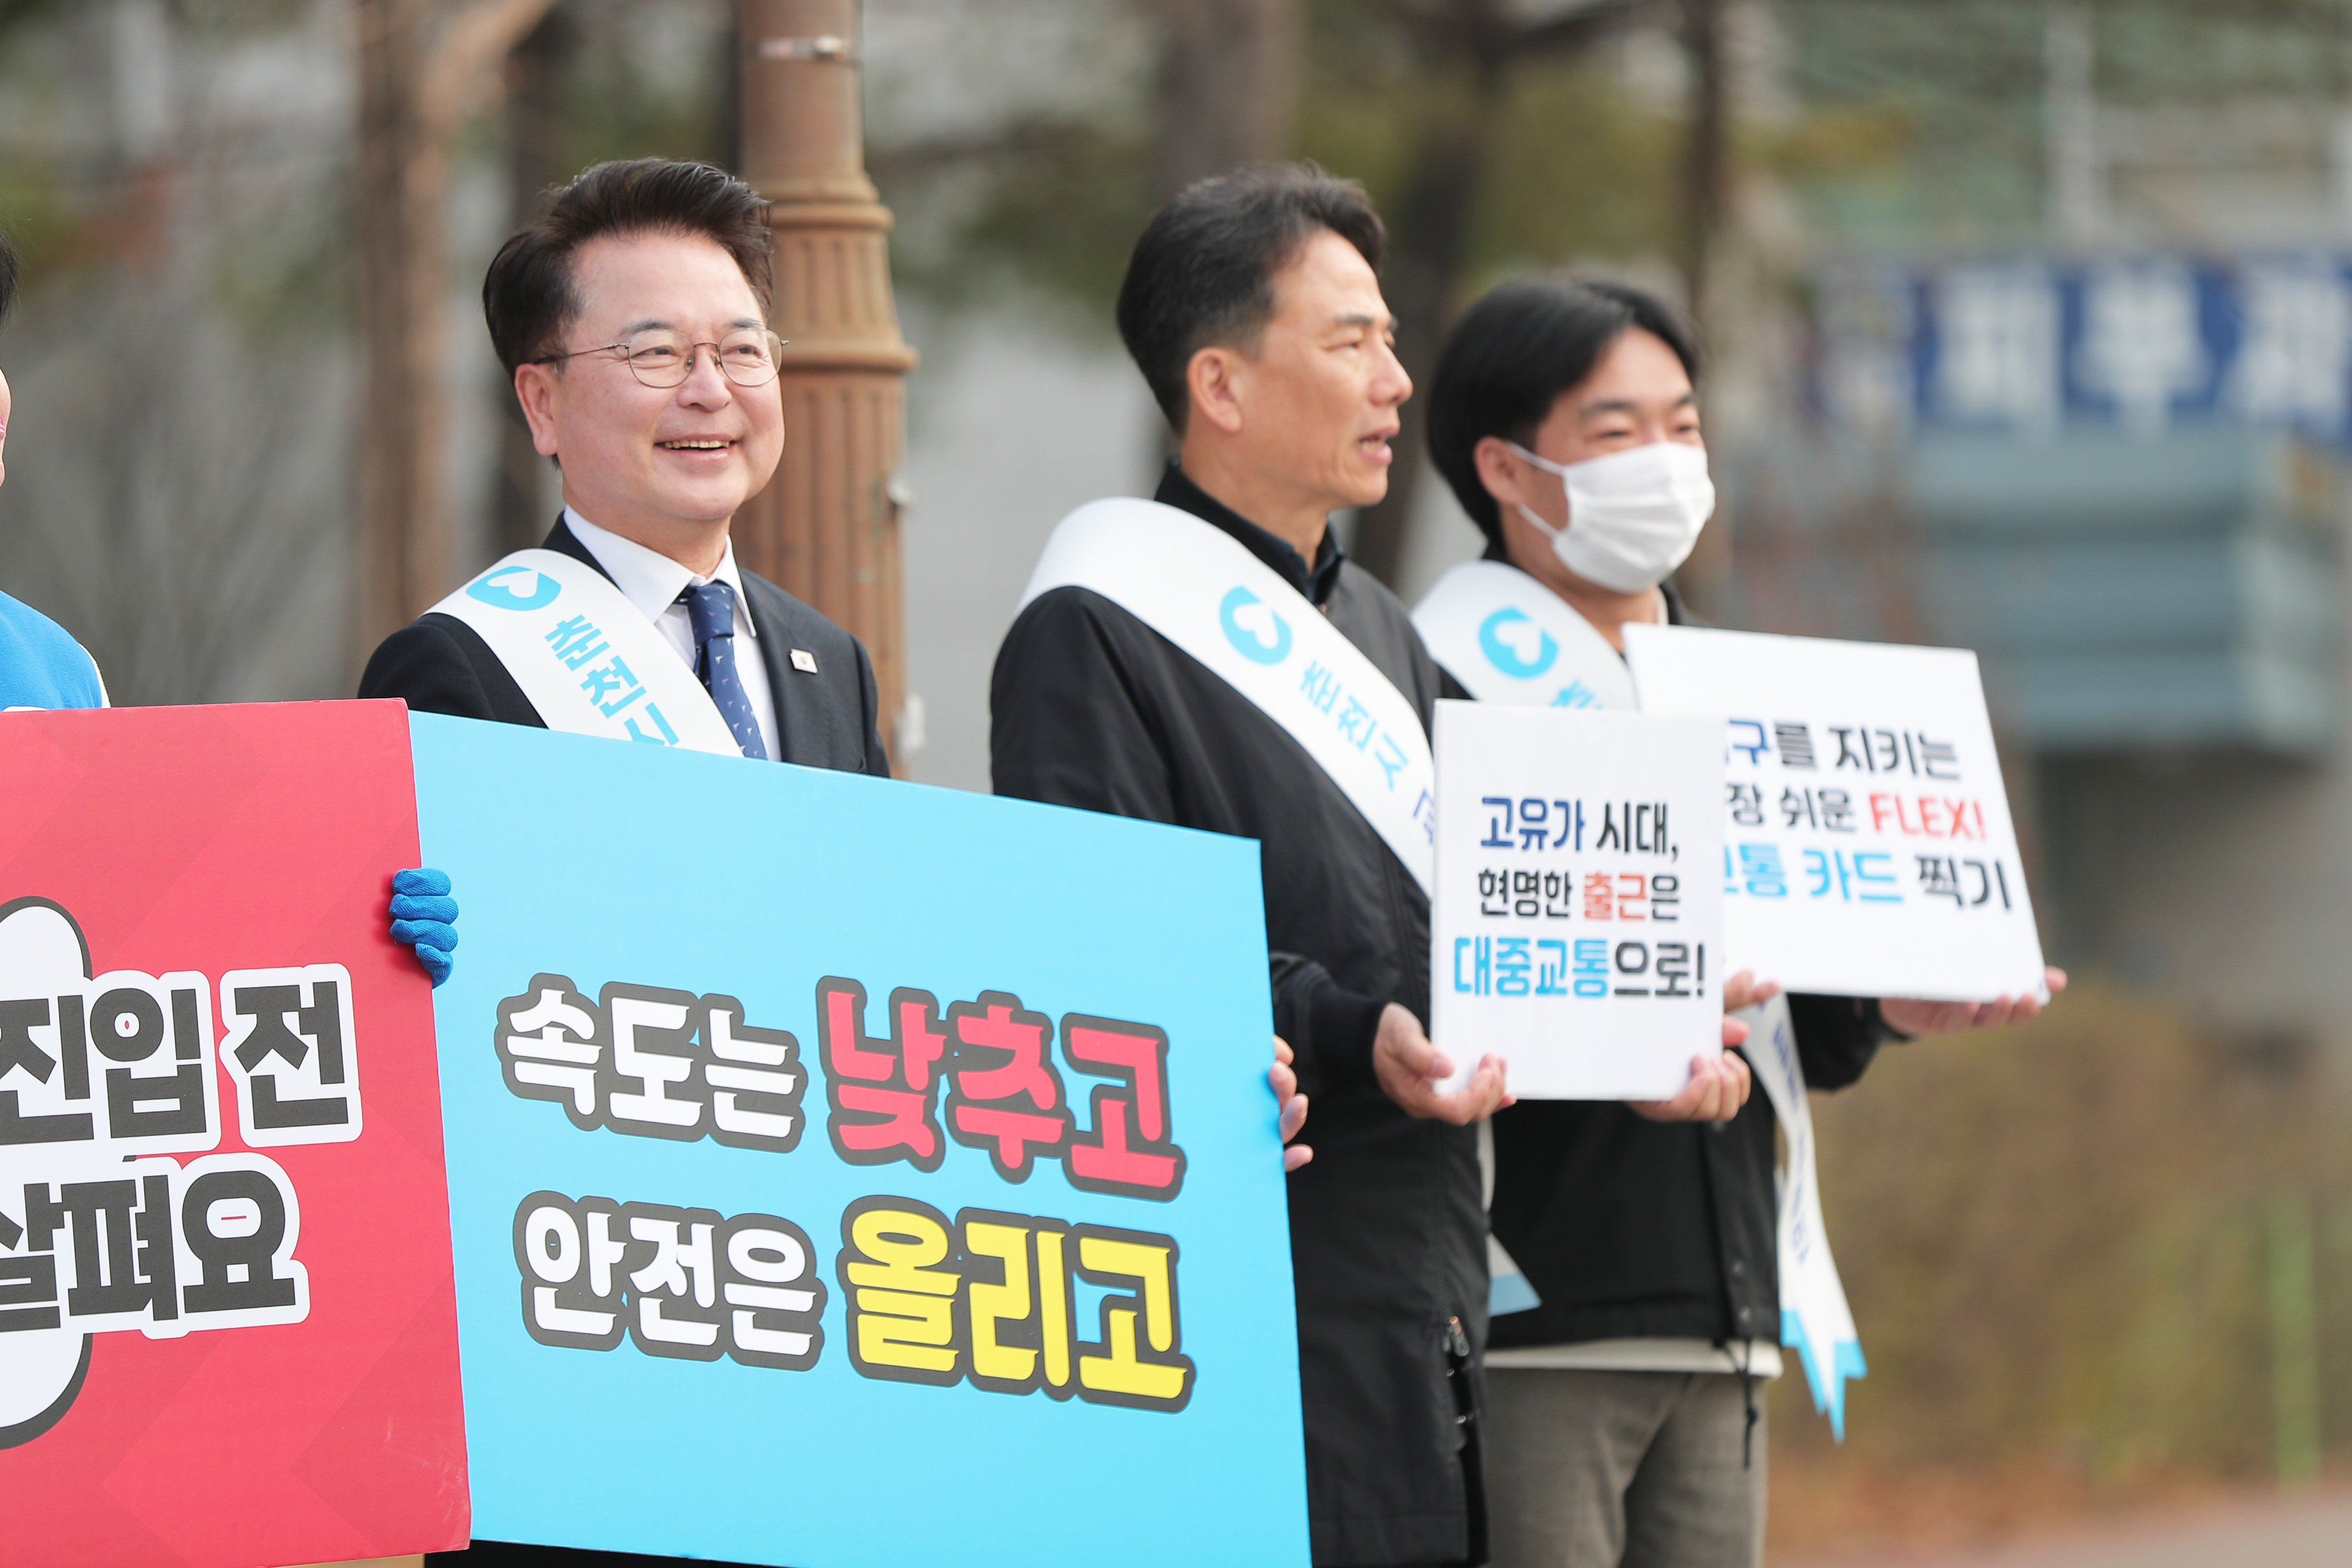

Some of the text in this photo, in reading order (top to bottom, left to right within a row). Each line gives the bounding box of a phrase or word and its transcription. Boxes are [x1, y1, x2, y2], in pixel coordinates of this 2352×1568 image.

[545, 614, 679, 746] 춘천시
[1300, 660, 1409, 792] 춘천시
[1725, 718, 1961, 780] 구를 지키는
[1480, 797, 1585, 852] 고유가
[1596, 802, 1680, 863] 시대,
[1781, 785, 1858, 833] 쉬운
[1870, 793, 1988, 841] FLEX!
[1478, 868, 1680, 921] 현명한 출근은
[1803, 848, 1904, 903] 카드
[1915, 852, 2012, 912] 찍기
[1455, 937, 1705, 999] 대중교통으로!
[0, 981, 349, 1142] 진입 전
[506, 989, 1177, 1188] 속도는 낮추고
[524, 1206, 1188, 1400] 안전은 올리고
